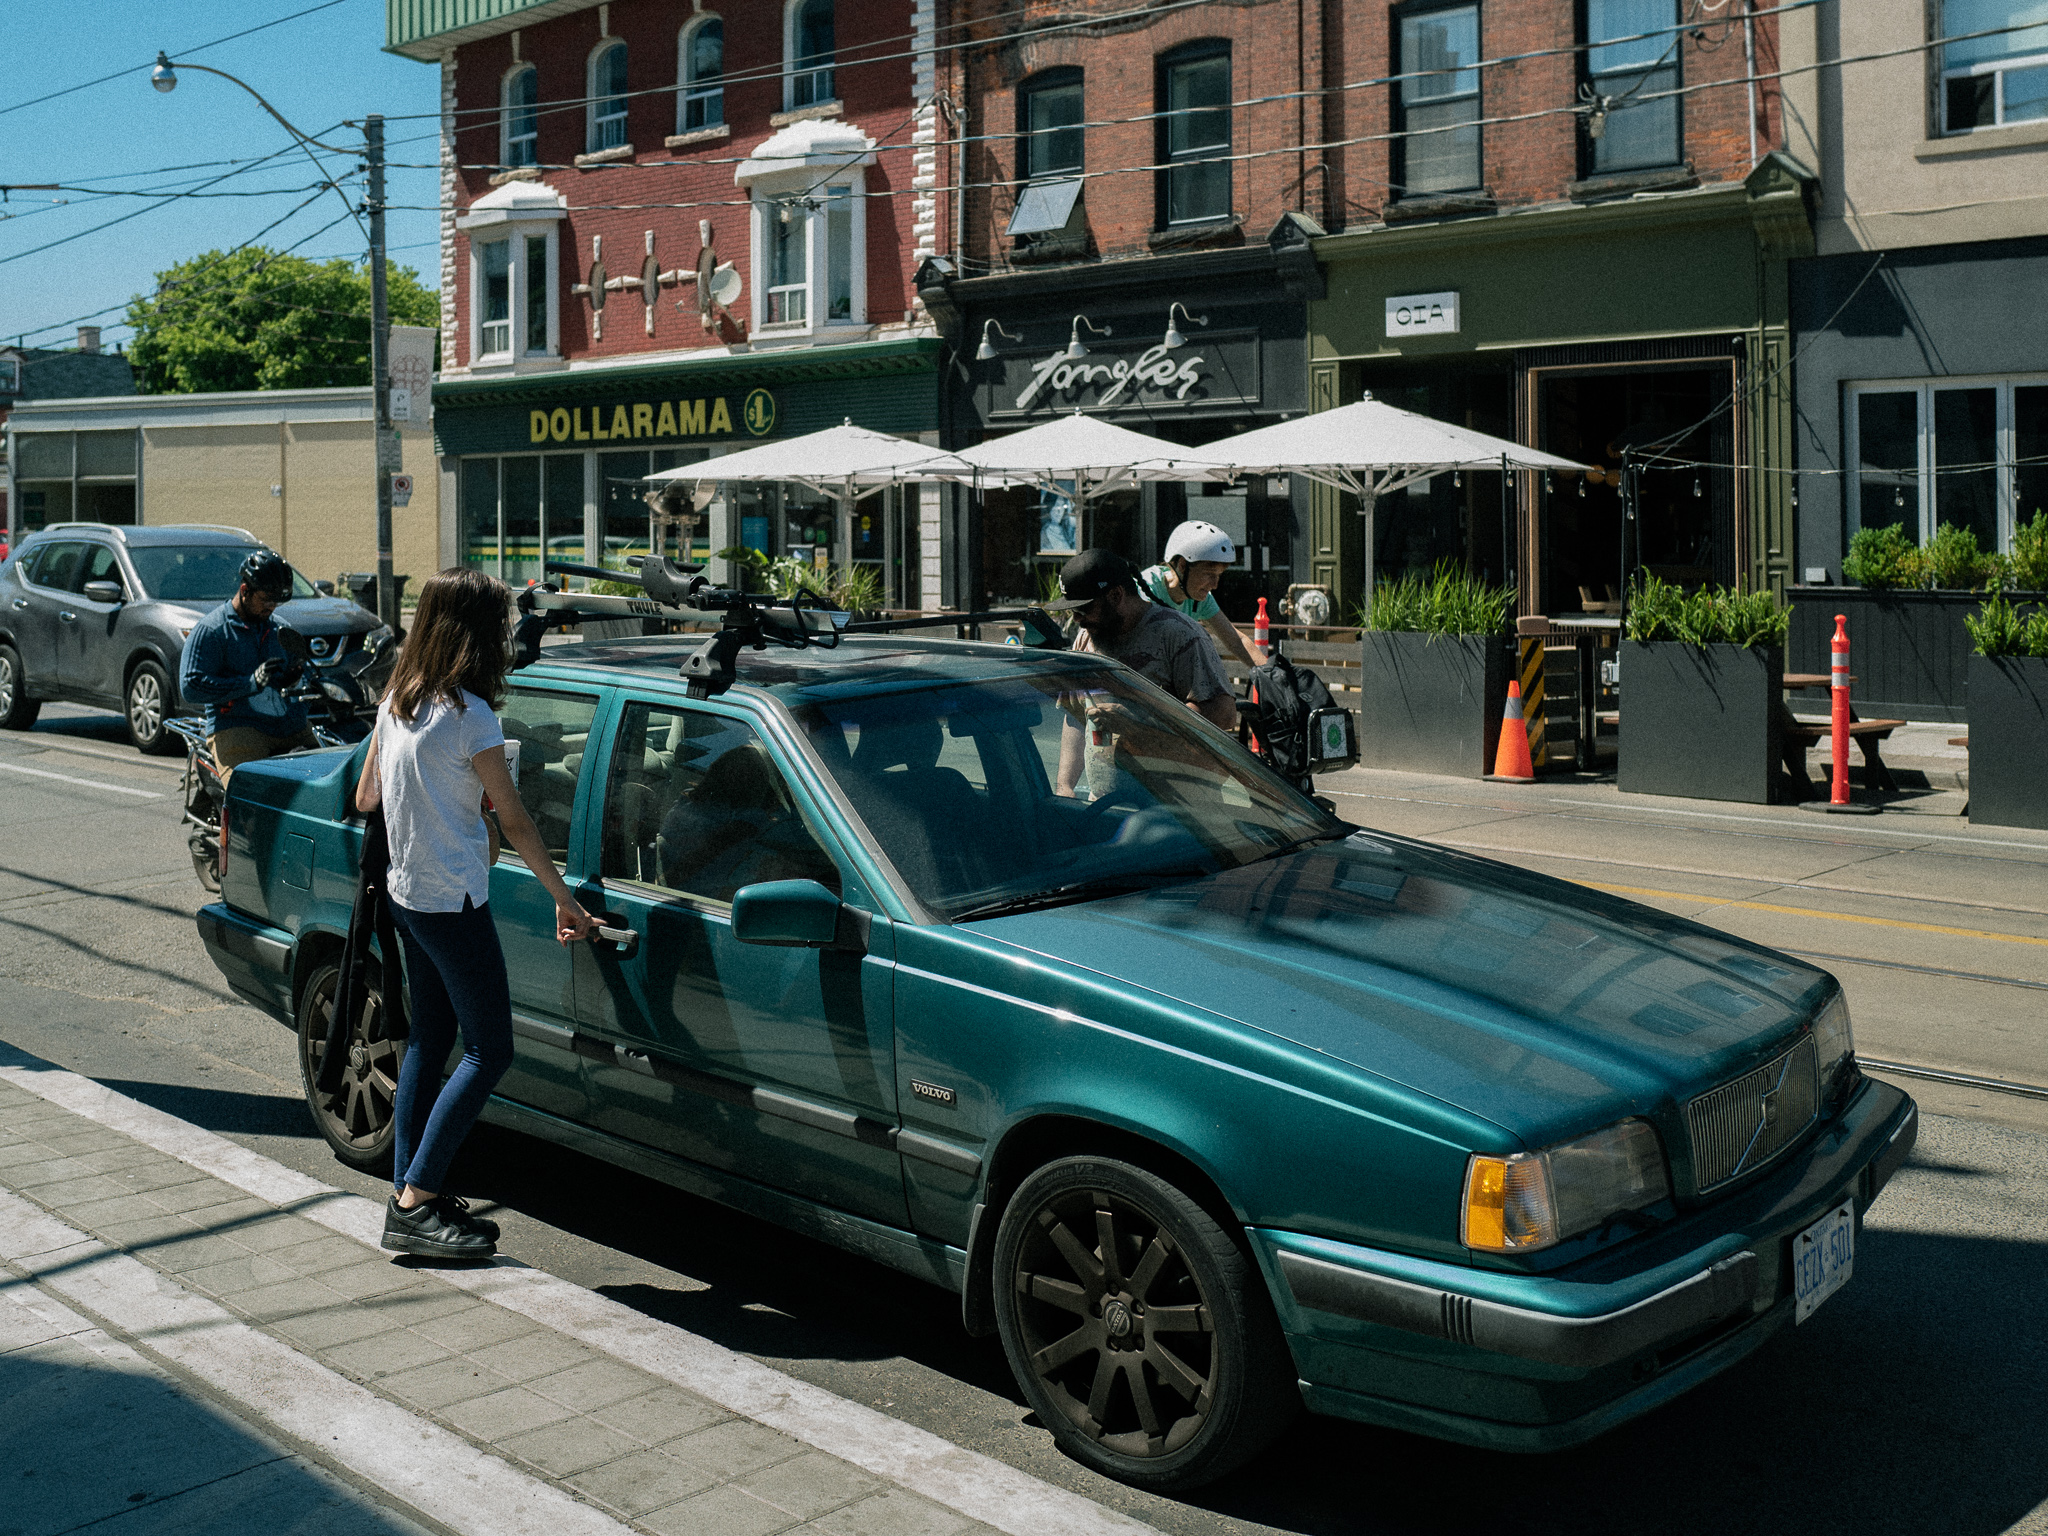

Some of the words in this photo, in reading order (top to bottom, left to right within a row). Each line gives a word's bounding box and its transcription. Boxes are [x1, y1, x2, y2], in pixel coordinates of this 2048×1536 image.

[1396, 304, 1445, 326] GIA
[1016, 344, 1204, 409] Tangles
[530, 397, 733, 443] DOLLARAMA
[626, 600, 664, 616] THULE
[912, 1082, 951, 1101] VOLVO
[1797, 1240, 1826, 1299] CEZX
[1831, 1221, 1852, 1271] 501
